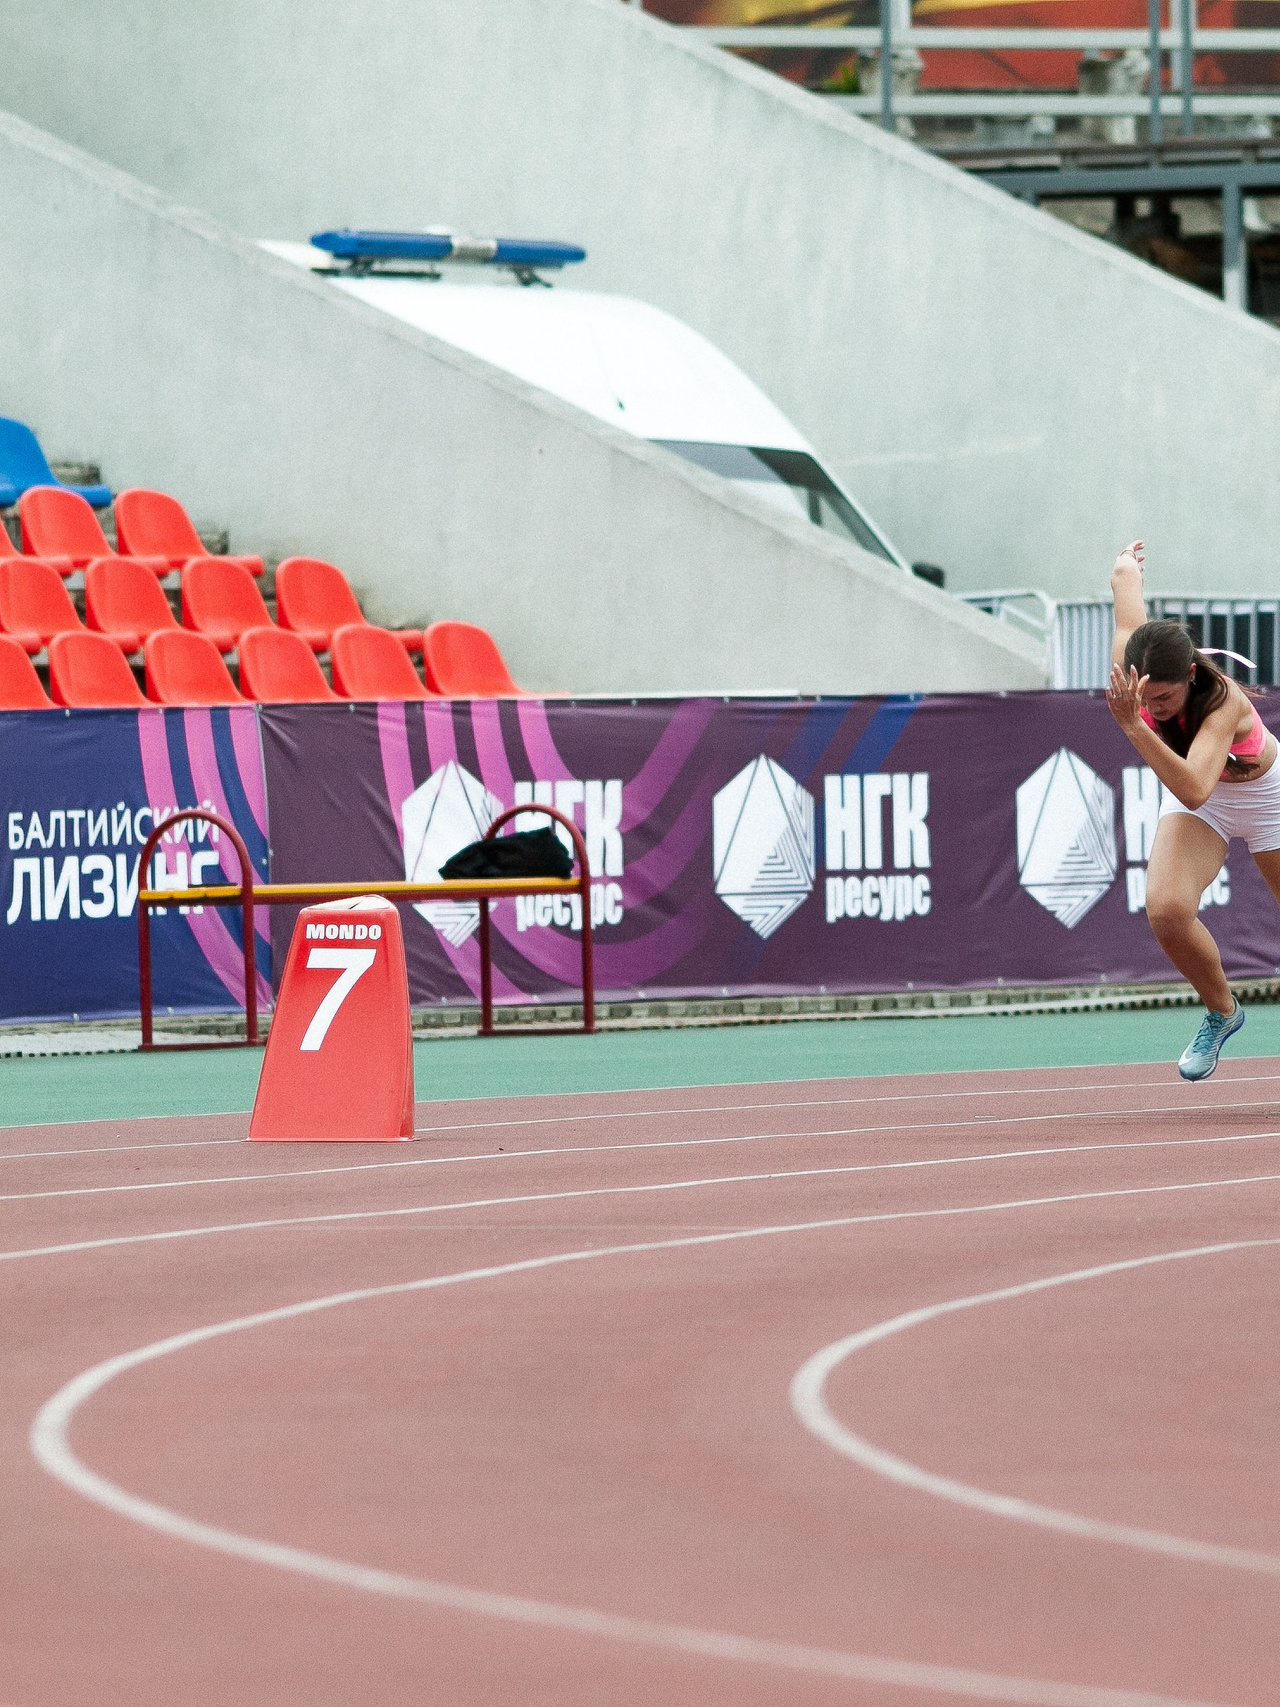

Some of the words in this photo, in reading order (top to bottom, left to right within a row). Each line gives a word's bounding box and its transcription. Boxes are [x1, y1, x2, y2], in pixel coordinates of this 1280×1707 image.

[8, 800, 220, 850] БАЛТИЙСКИЙ
[824, 773, 931, 870] НГК
[826, 874, 932, 923] ресурс
[305, 924, 382, 940] MONDO
[299, 948, 377, 1051] 7
